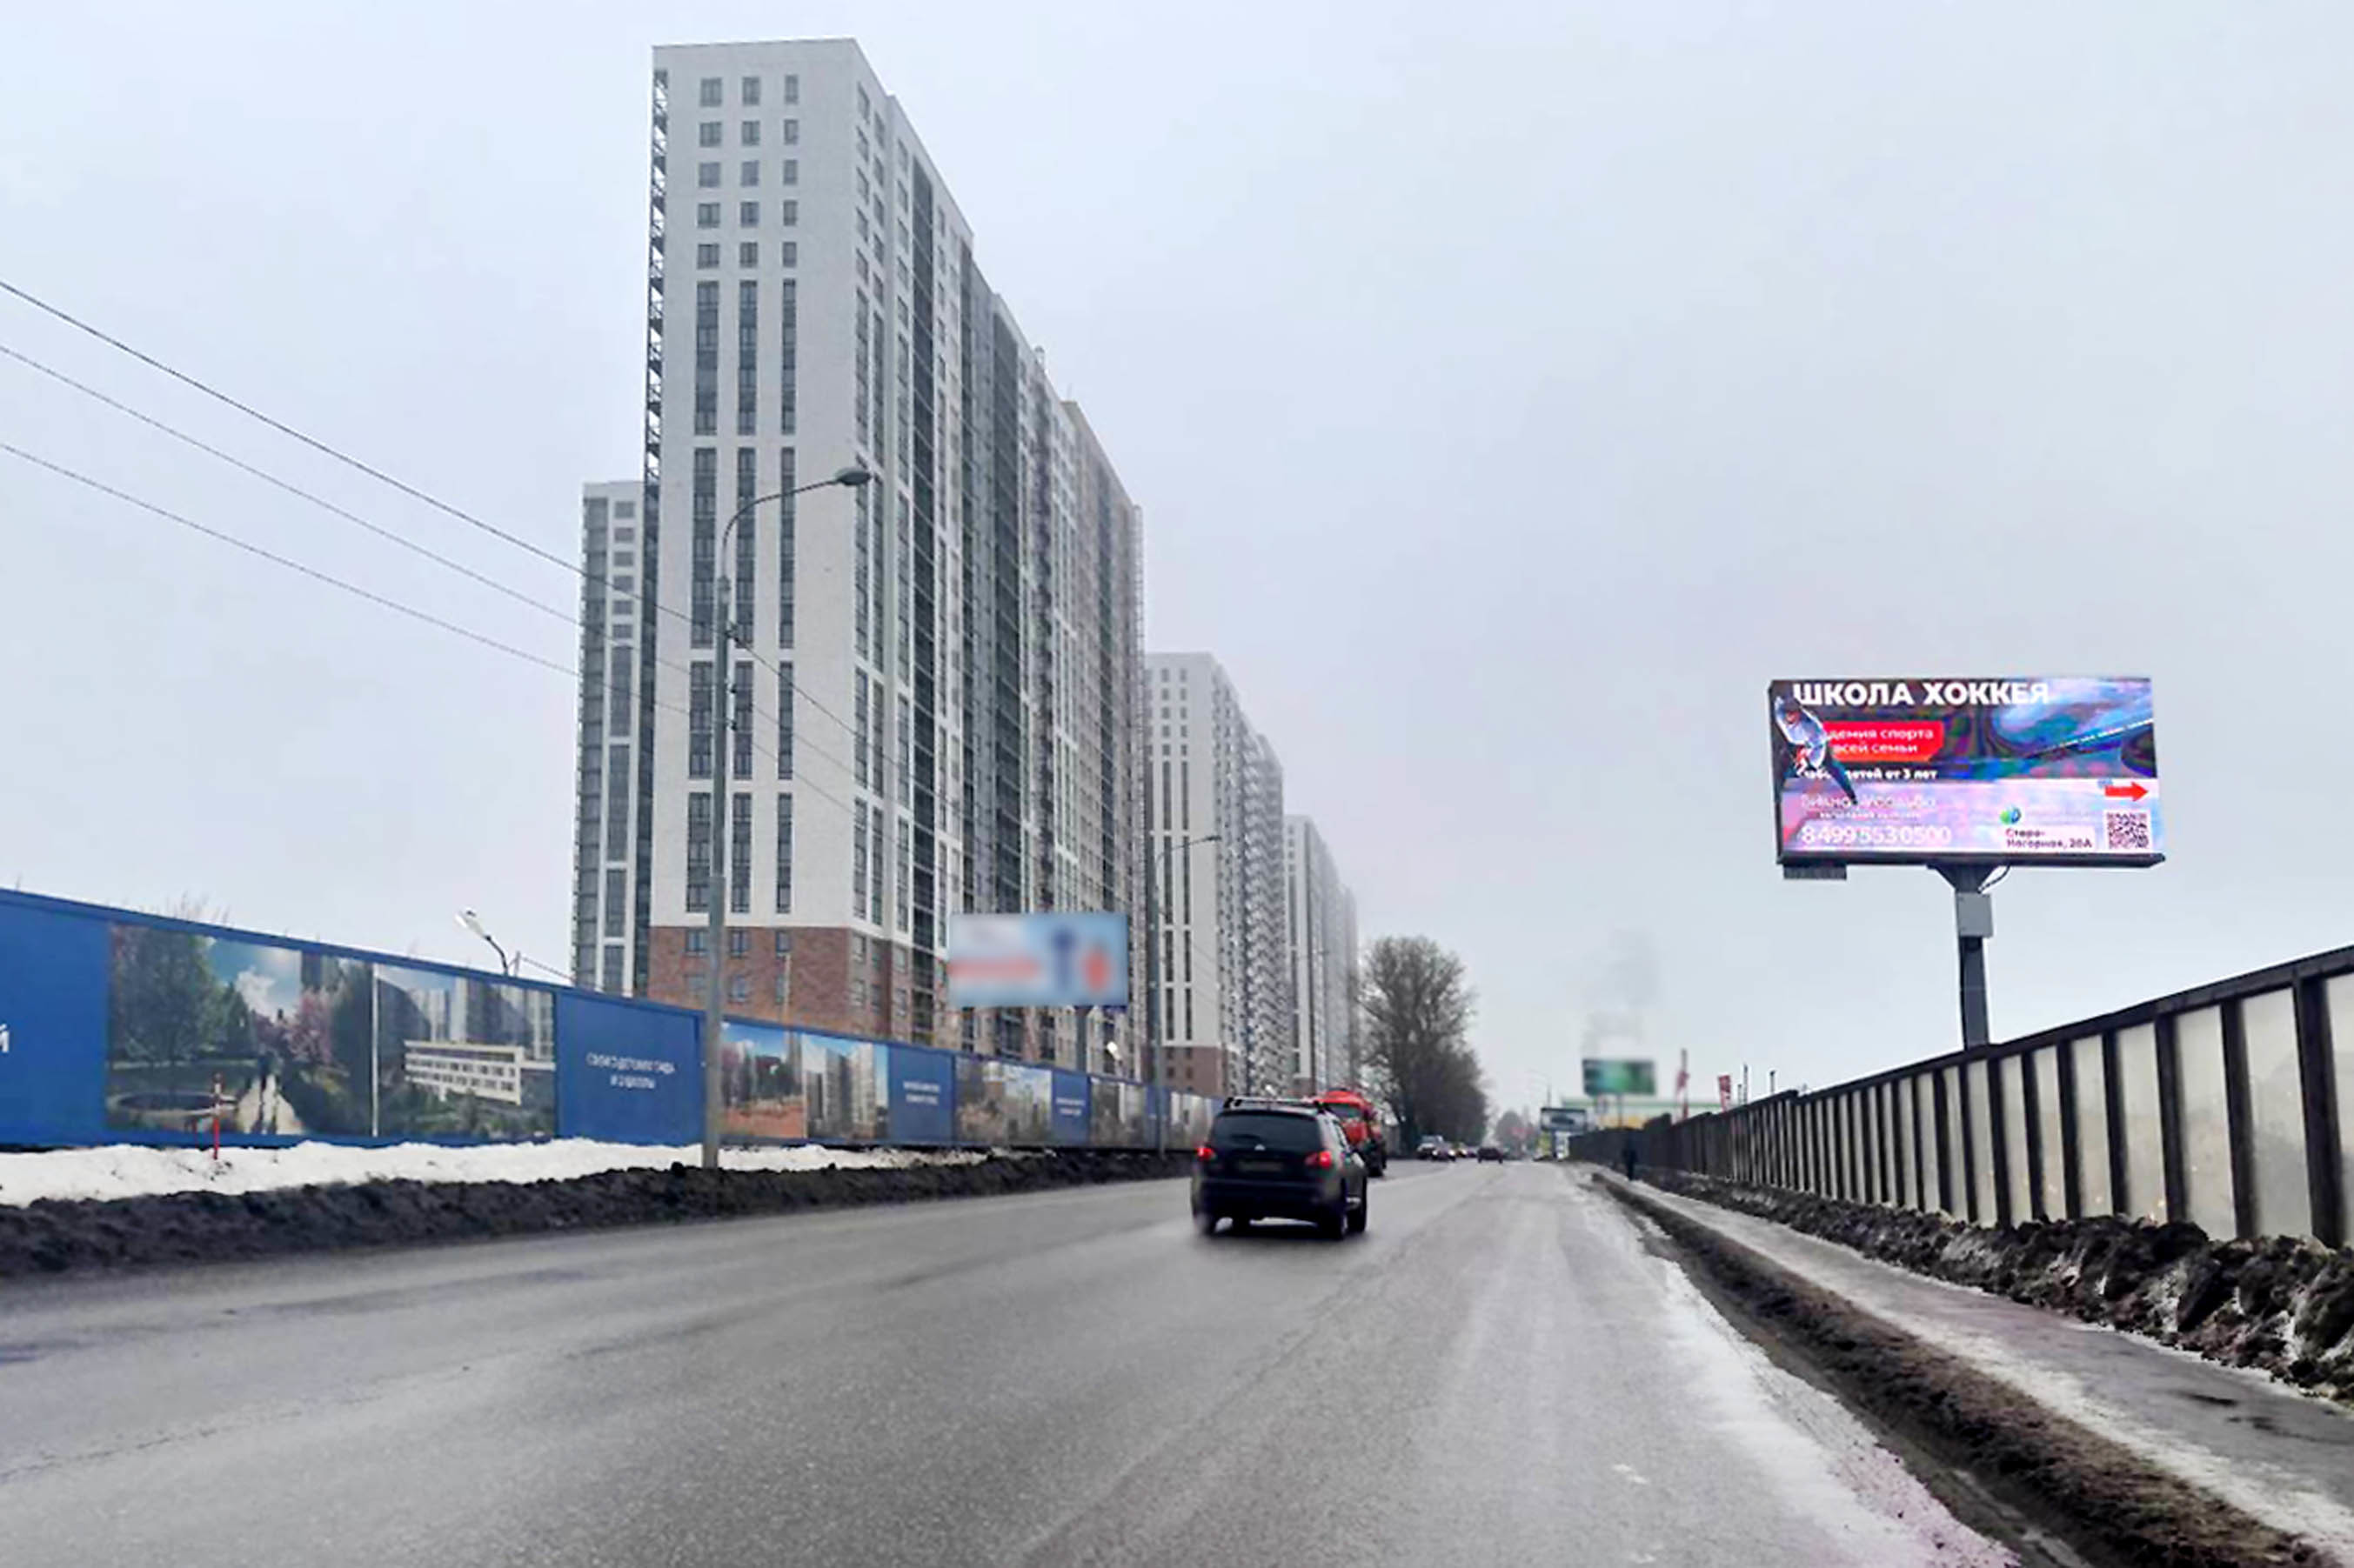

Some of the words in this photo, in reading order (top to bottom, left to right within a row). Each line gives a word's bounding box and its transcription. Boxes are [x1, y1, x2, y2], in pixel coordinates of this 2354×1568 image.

[1793, 683, 1916, 706] ШКОЛА
[1922, 682, 2049, 705] ХОККЕЯ
[1879, 729, 1934, 743] спорта
[1871, 744, 1919, 754] семьи
